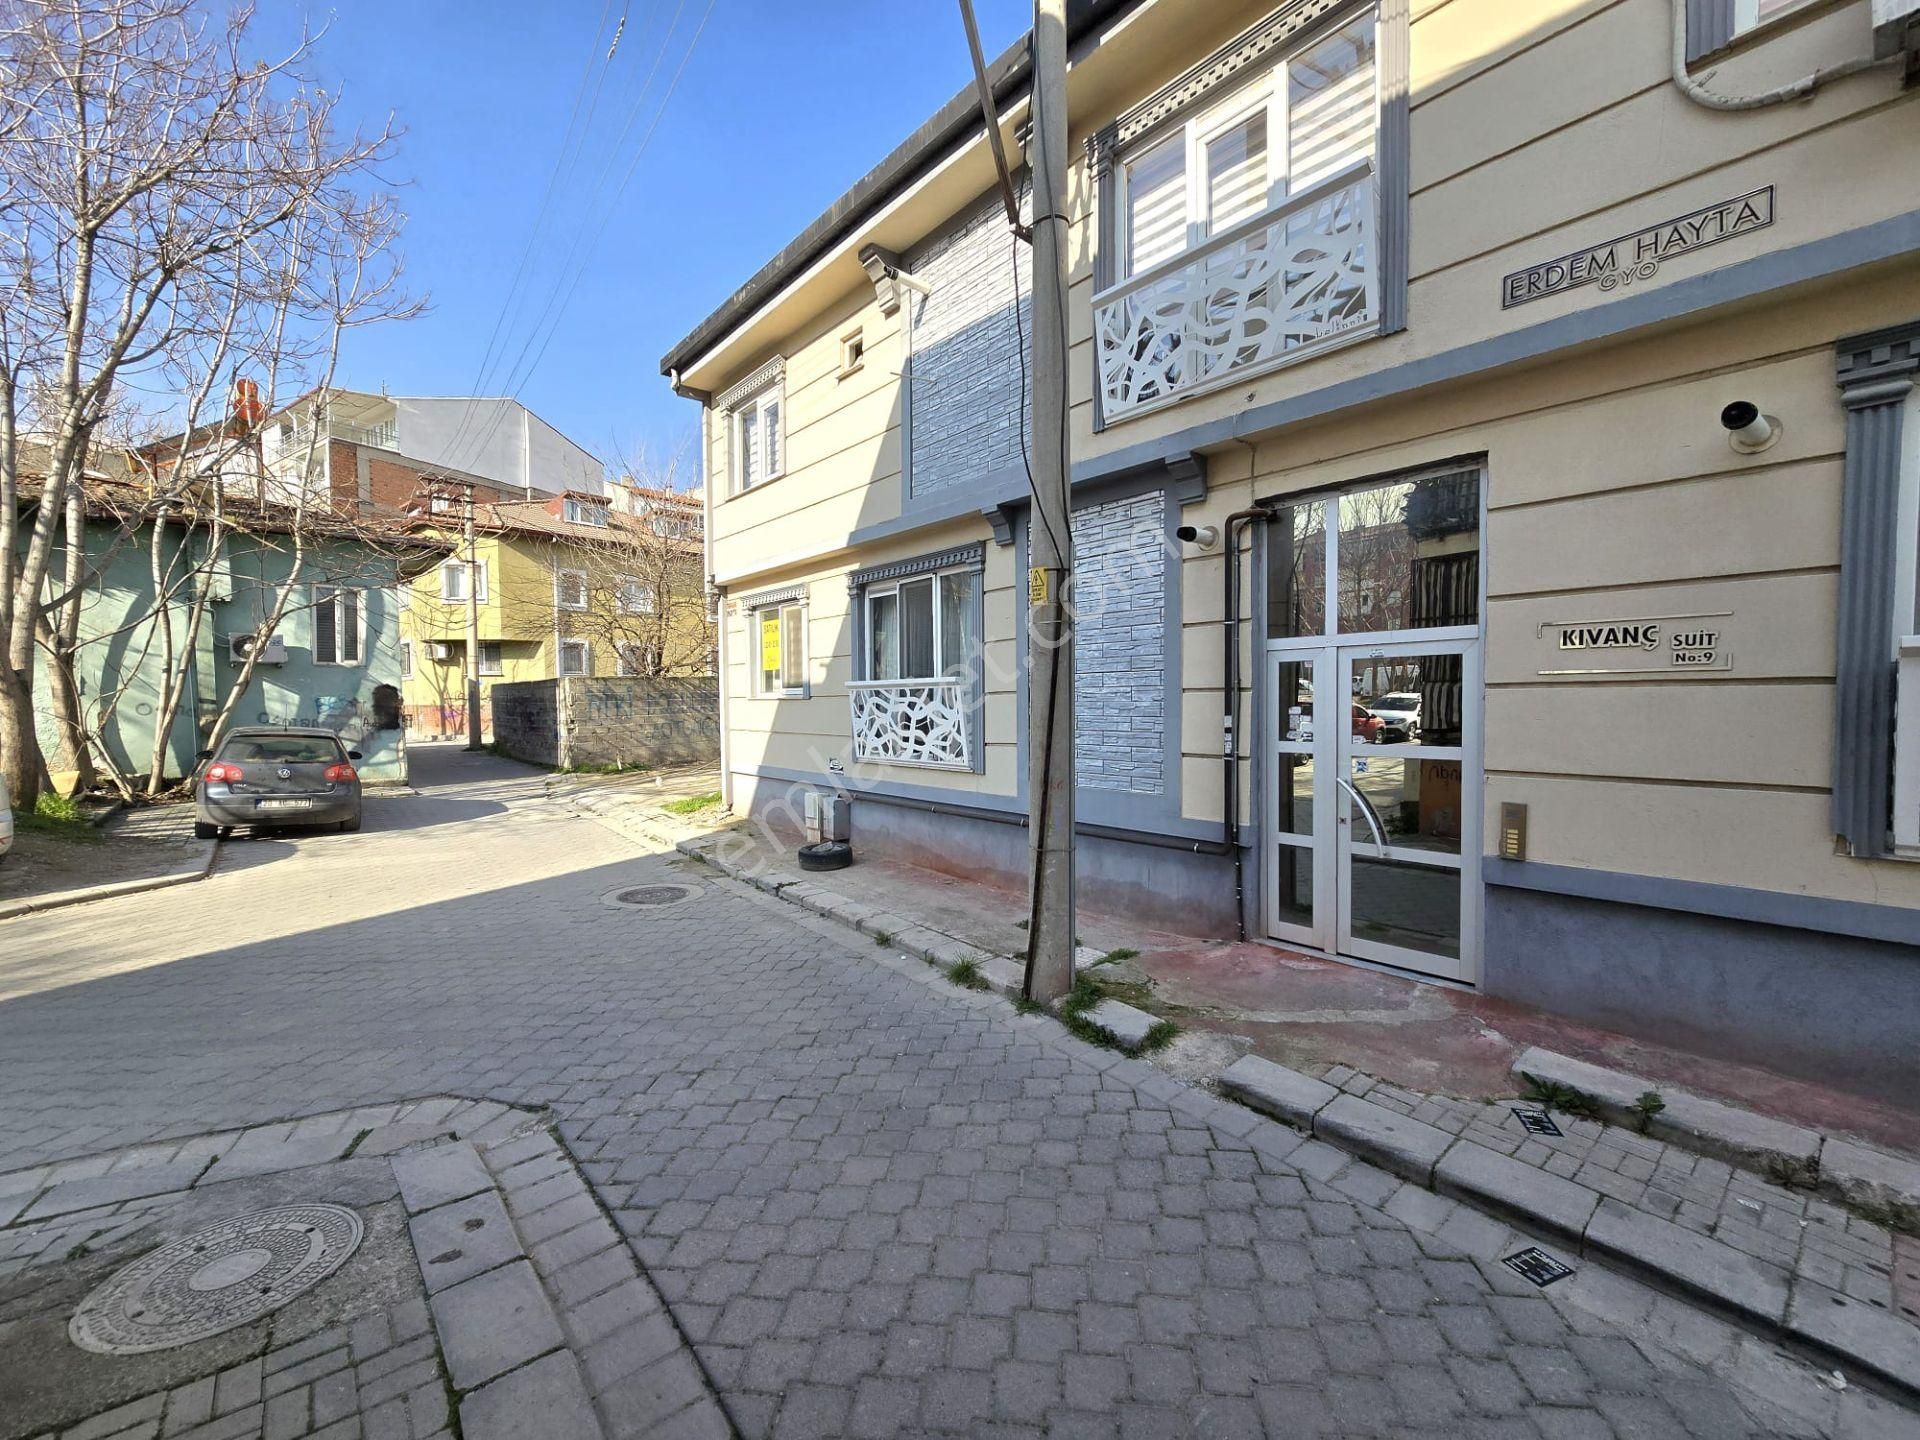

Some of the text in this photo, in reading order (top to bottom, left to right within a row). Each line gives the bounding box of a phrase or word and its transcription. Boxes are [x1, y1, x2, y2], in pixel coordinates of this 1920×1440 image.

[1509, 199, 1763, 301] ERDEM HAYTA
[1599, 259, 1660, 291] GYO
[1562, 624, 1716, 651] KIVANÇ SUİT
[1674, 651, 1714, 663] No:9
